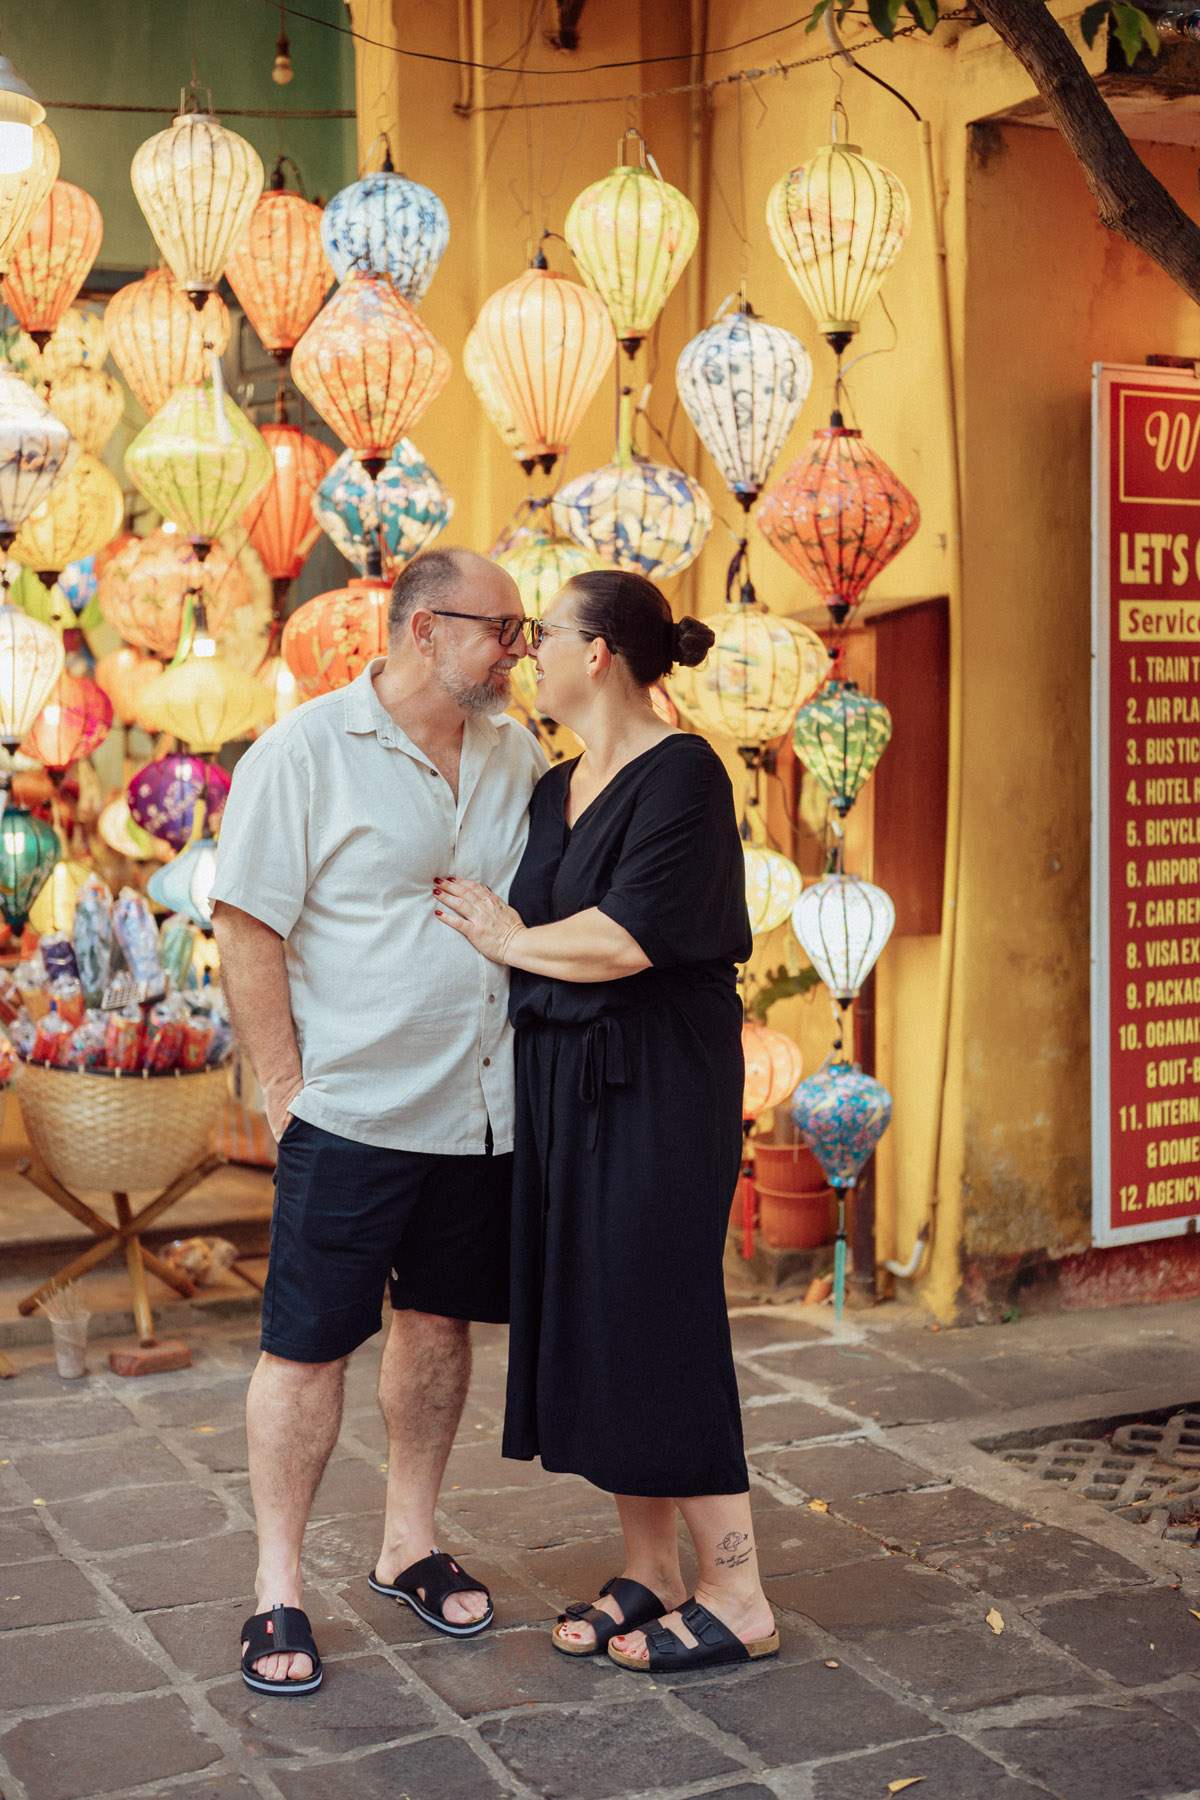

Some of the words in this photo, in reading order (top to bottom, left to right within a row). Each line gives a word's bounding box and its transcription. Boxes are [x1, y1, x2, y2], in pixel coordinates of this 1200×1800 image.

[1120, 532, 1189, 585] LET'S
[1128, 607, 1200, 634] Servic
[1129, 657, 1141, 682] 1.
[1146, 657, 1189, 682] TRAIN
[1127, 697, 1141, 723] 2.
[1146, 697, 1171, 723] AIR
[1127, 738, 1141, 764] 3.
[1146, 738, 1175, 764] BUS
[1126, 780, 1141, 805] 4.
[1146, 778, 1191, 805] HOTEL
[1127, 820, 1141, 846] 5.
[1127, 861, 1141, 887] 6.
[1127, 901, 1141, 928] 7.
[1146, 899, 1175, 927] CAR
[1126, 942, 1141, 969] 8.
[1145, 939, 1179, 968] VISA
[1126, 982, 1141, 1010] 9.
[1118, 1023, 1141, 1051] 10.
[1146, 1017, 1200, 1049] OGANAI
[1146, 1061, 1157, 1089] &
[1119, 1104, 1142, 1131] 11.
[1146, 1141, 1157, 1169] &
[1119, 1183, 1142, 1212] 12.
